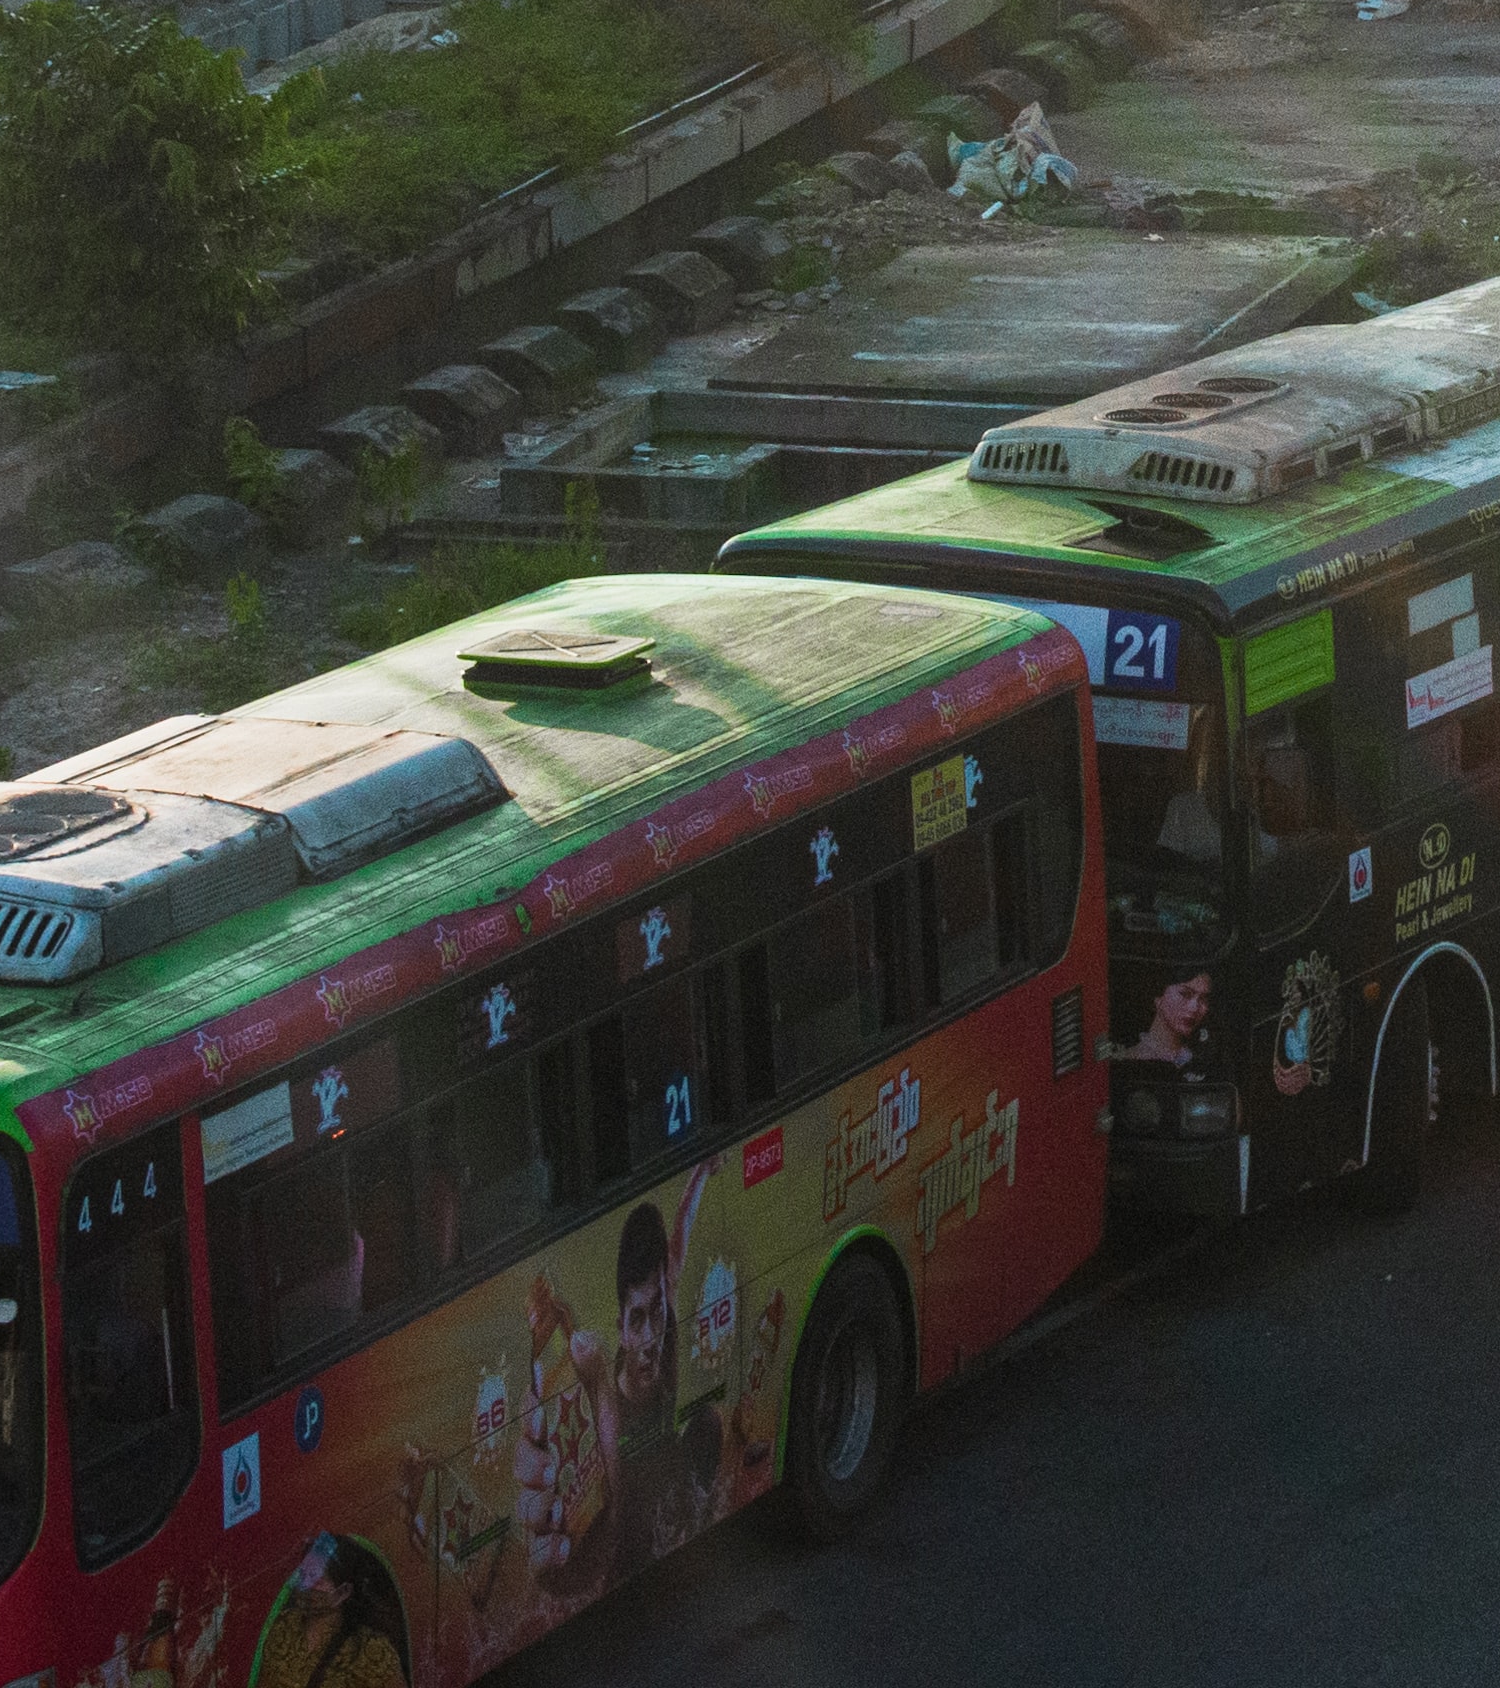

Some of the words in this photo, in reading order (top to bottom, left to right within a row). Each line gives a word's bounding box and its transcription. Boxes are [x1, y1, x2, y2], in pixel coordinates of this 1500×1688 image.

[1113, 624, 1169, 679] 21
[1395, 872, 1433, 918] HEIN
[1436, 862, 1456, 899] NA
[1460, 852, 1477, 887] DI
[665, 1075, 691, 1137] 21
[77, 1194, 94, 1233] 4
[110, 1178, 126, 1216] 4
[143, 1161, 158, 1199] 4
